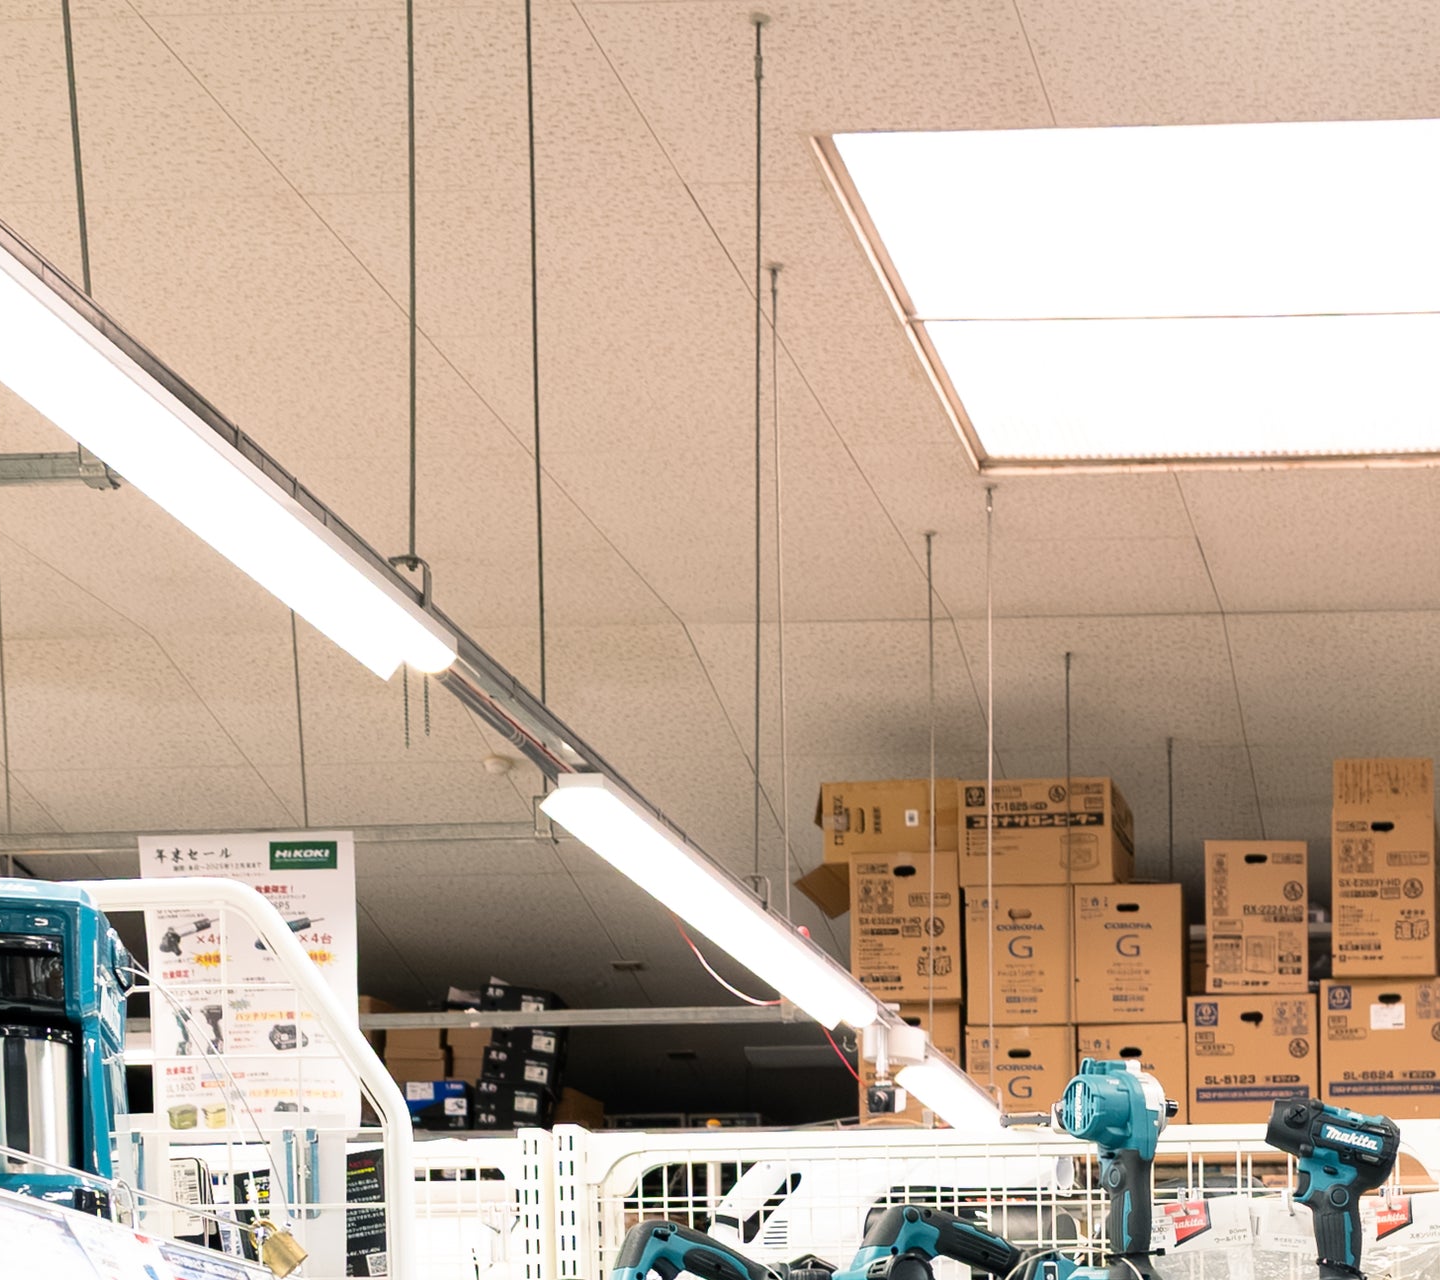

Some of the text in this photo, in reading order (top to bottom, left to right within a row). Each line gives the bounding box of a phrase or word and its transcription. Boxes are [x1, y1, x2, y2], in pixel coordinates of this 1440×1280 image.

[1008, 935, 1033, 959] G
[1116, 934, 1140, 958] G
[1008, 1076, 1033, 1099] G
[1326, 1124, 1378, 1153] Makita
